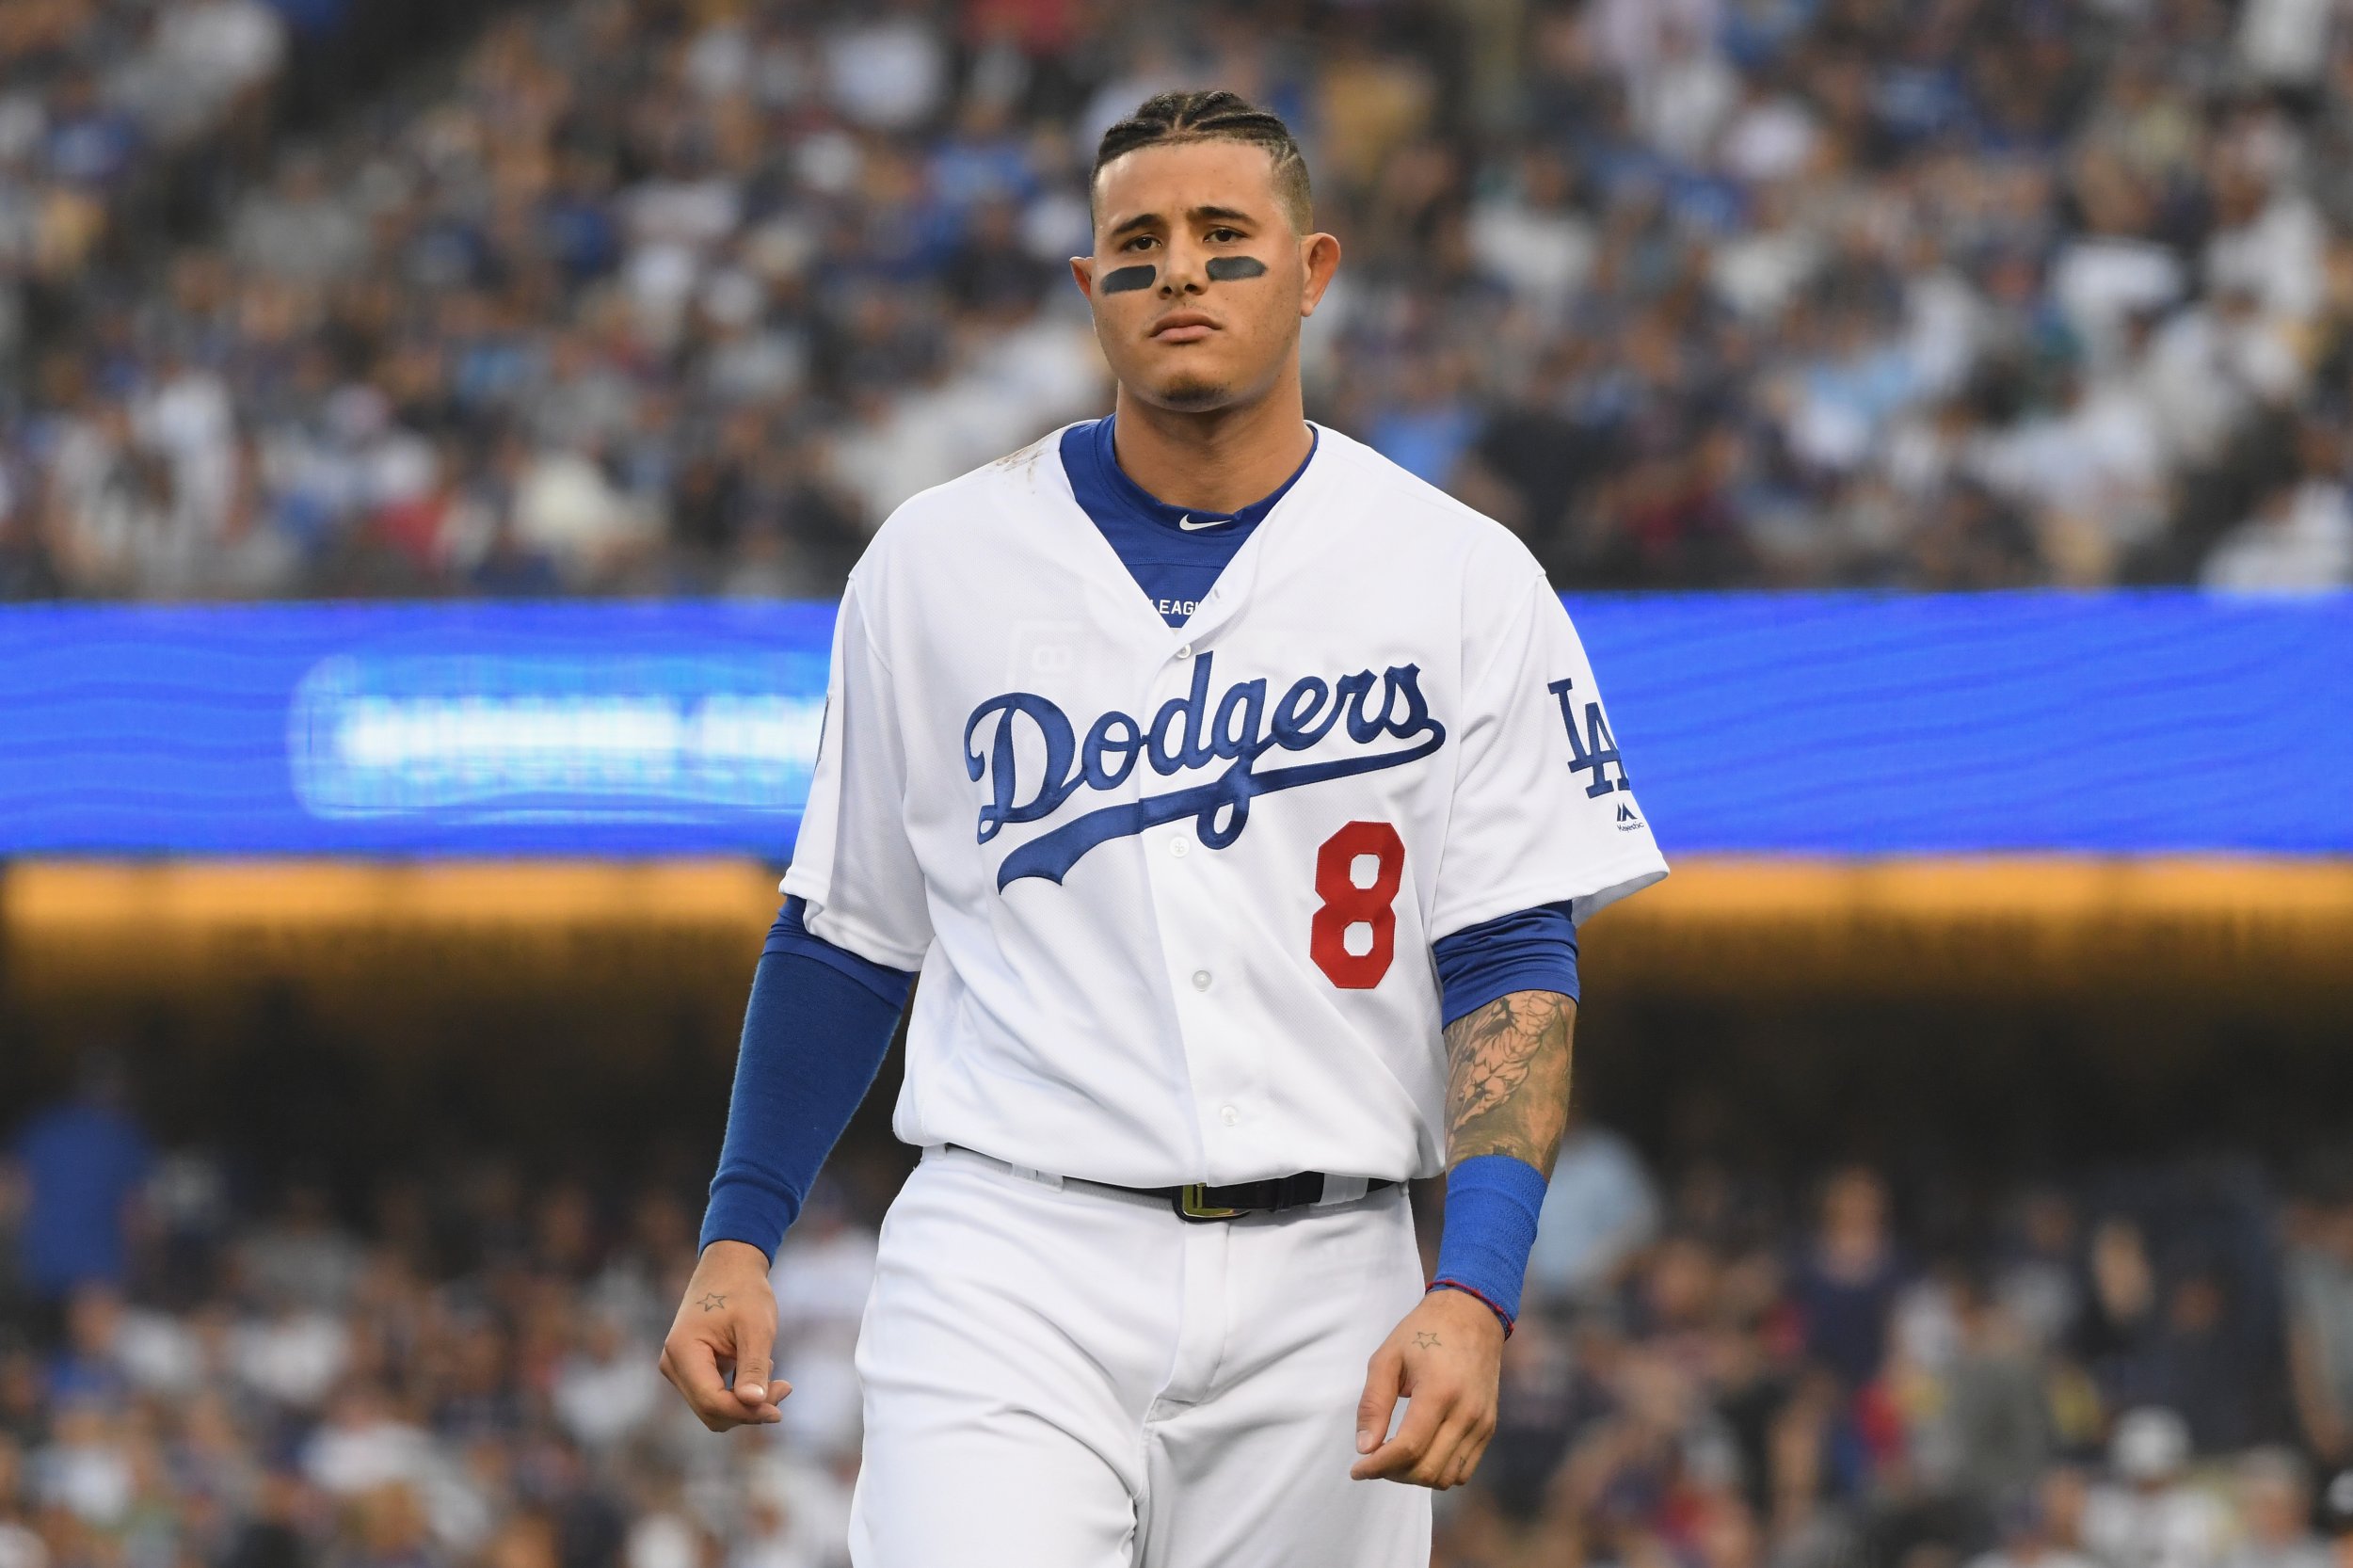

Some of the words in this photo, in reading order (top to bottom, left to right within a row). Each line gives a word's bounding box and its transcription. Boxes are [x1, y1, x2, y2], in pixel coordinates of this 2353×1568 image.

[1149, 599, 1200, 616] EAG
[964, 650, 1447, 851] Dodgers
[1547, 678, 1631, 799] LA
[1310, 821, 1405, 989] 8
